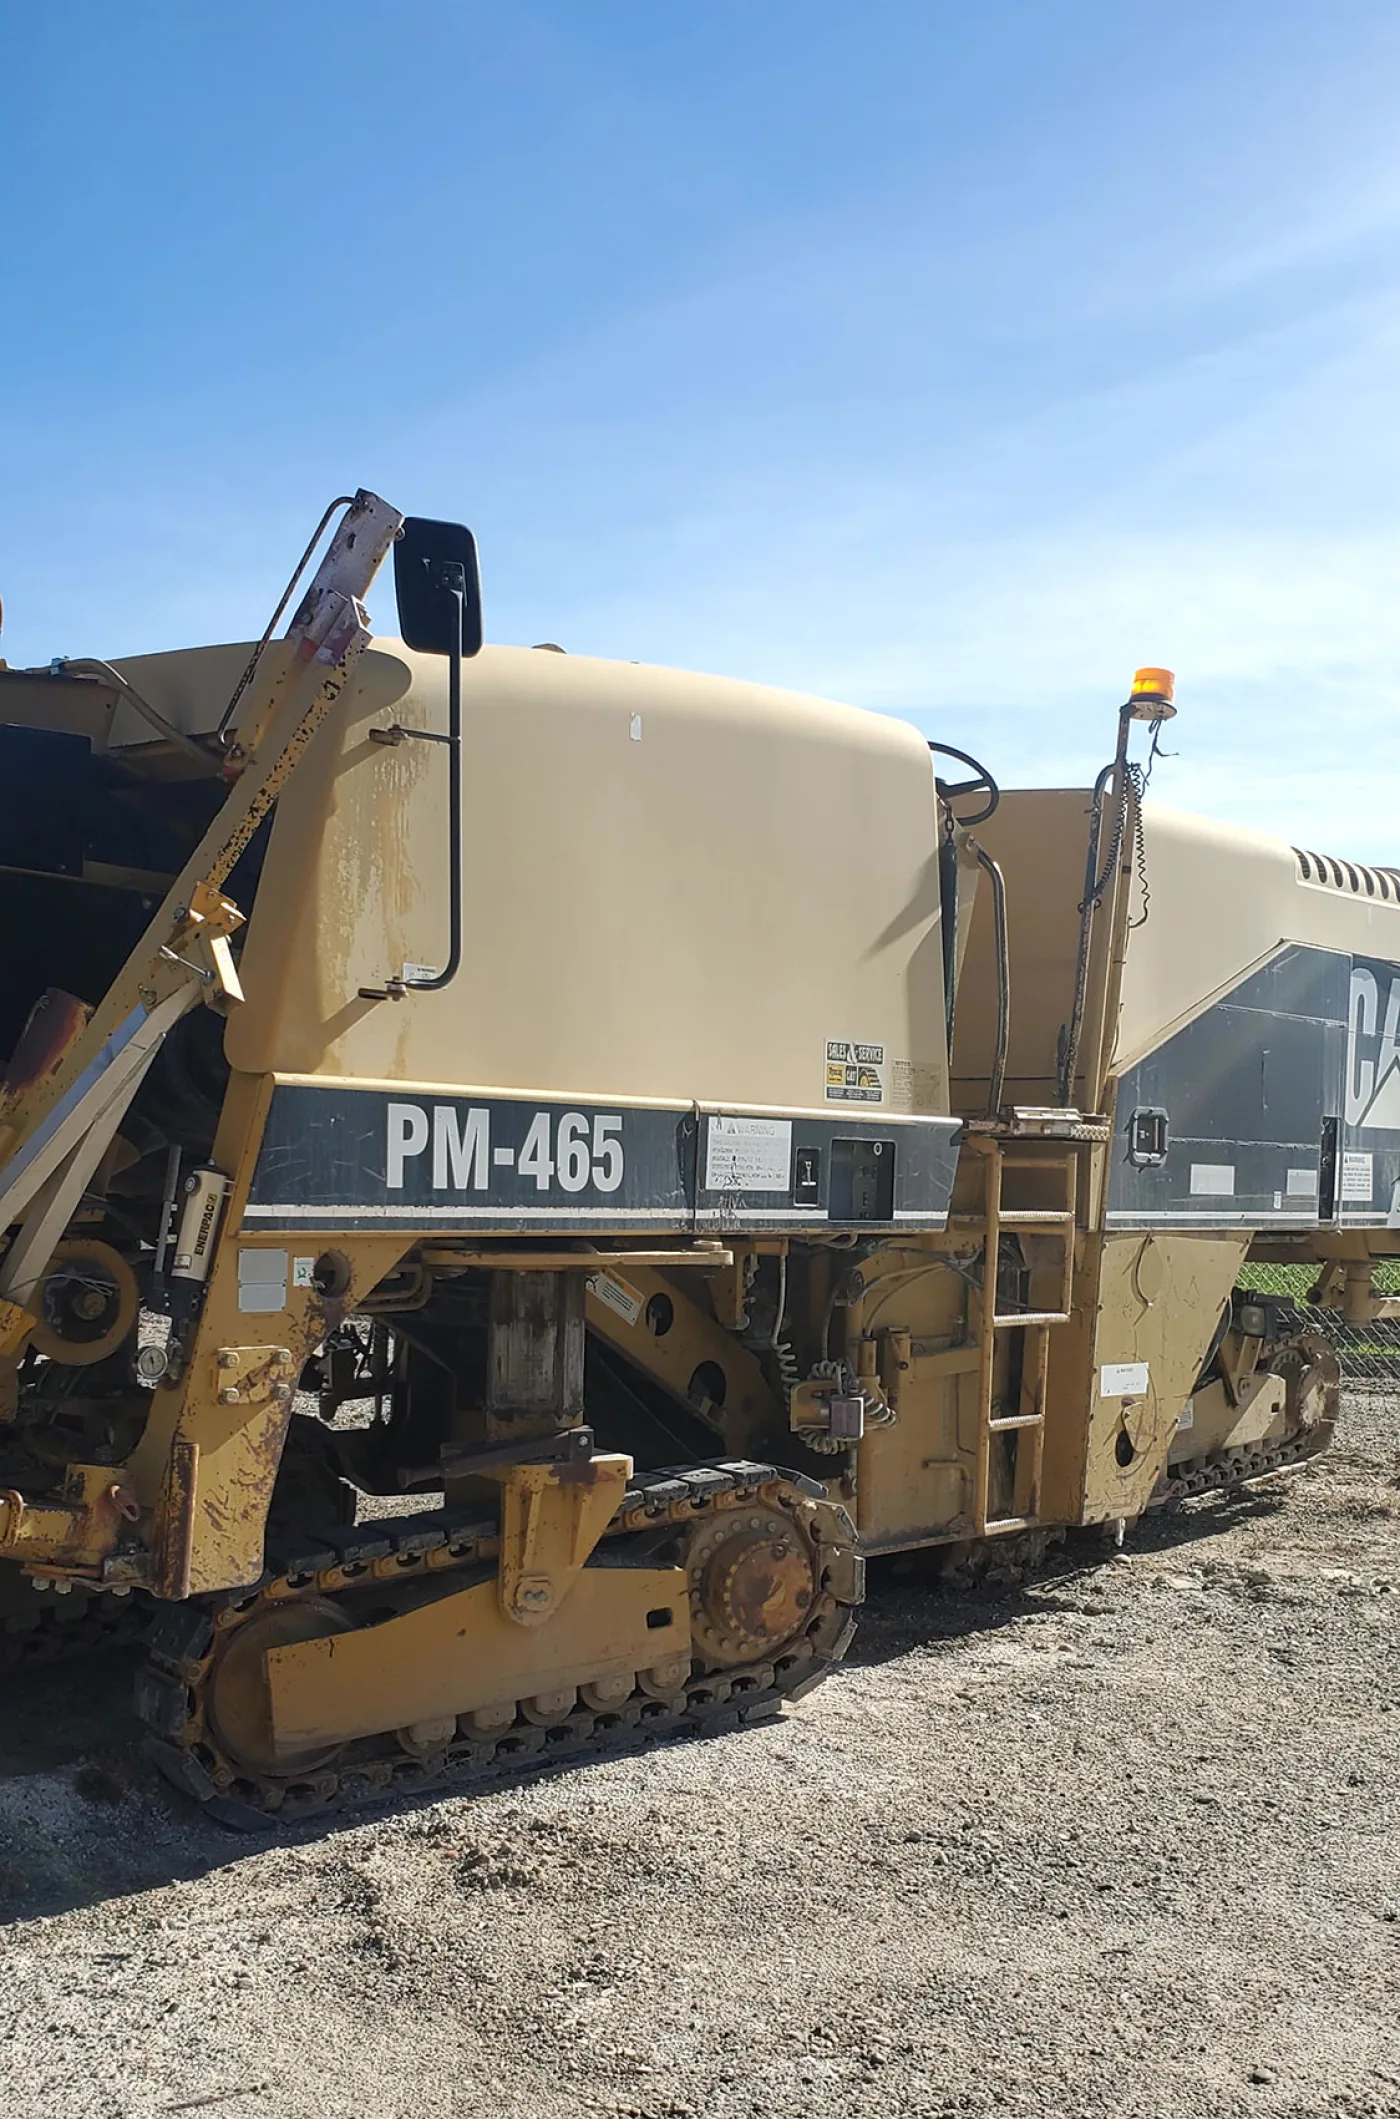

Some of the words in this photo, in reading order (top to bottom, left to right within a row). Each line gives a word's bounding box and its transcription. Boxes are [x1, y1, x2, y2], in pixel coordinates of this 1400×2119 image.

[828, 1043, 847, 1060] SALES
[858, 1046, 883, 1062] SERVICE
[386, 1103, 624, 1192] PM-465
[194, 1204, 215, 1257] ENERPAC
